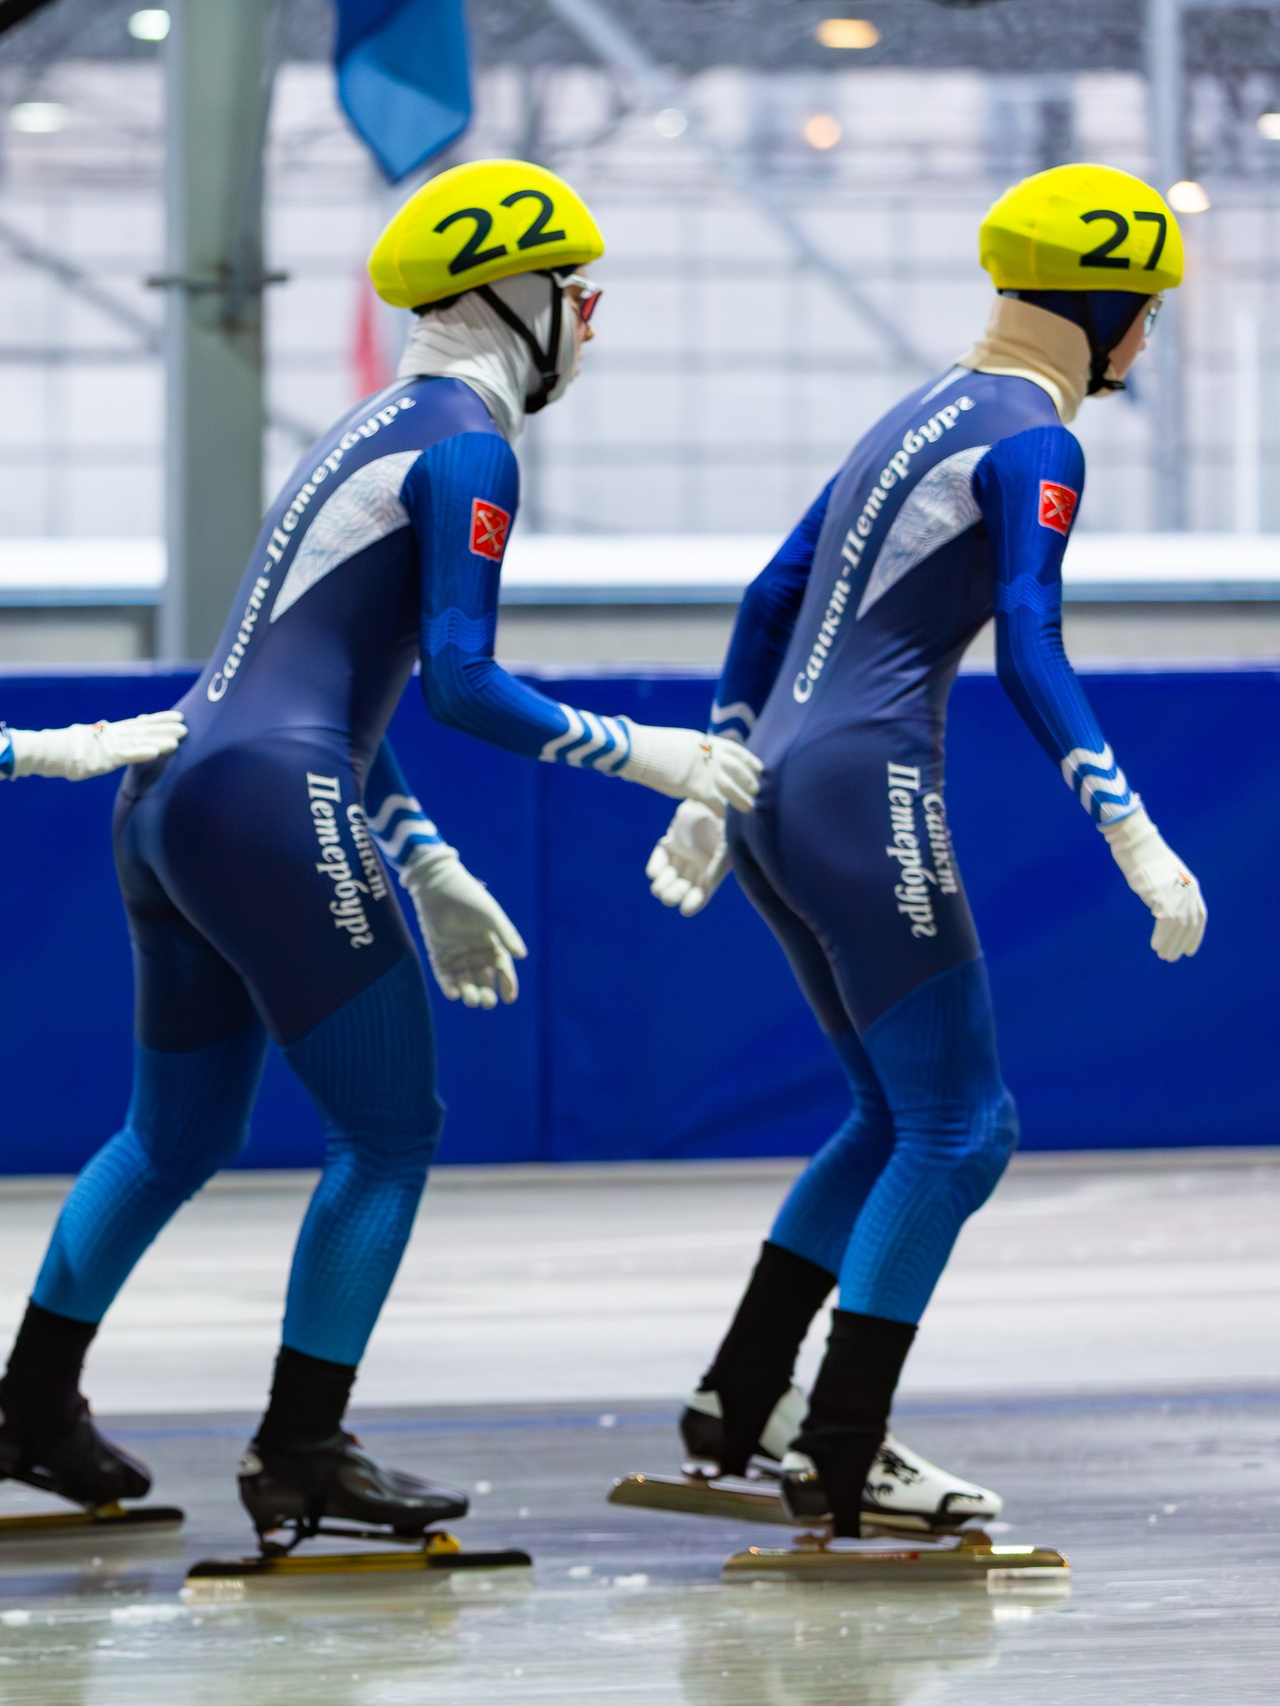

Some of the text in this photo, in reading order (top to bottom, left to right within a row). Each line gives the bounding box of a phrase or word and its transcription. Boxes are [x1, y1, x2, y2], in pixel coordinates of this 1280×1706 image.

[432, 189, 566, 276] 22
[1079, 208, 1168, 271] 27
[207, 396, 417, 703] Санкт-Петербург
[792, 395, 977, 704] Санкт-Петербург
[306, 771, 374, 949] Петербург
[886, 760, 938, 938] Петербург
